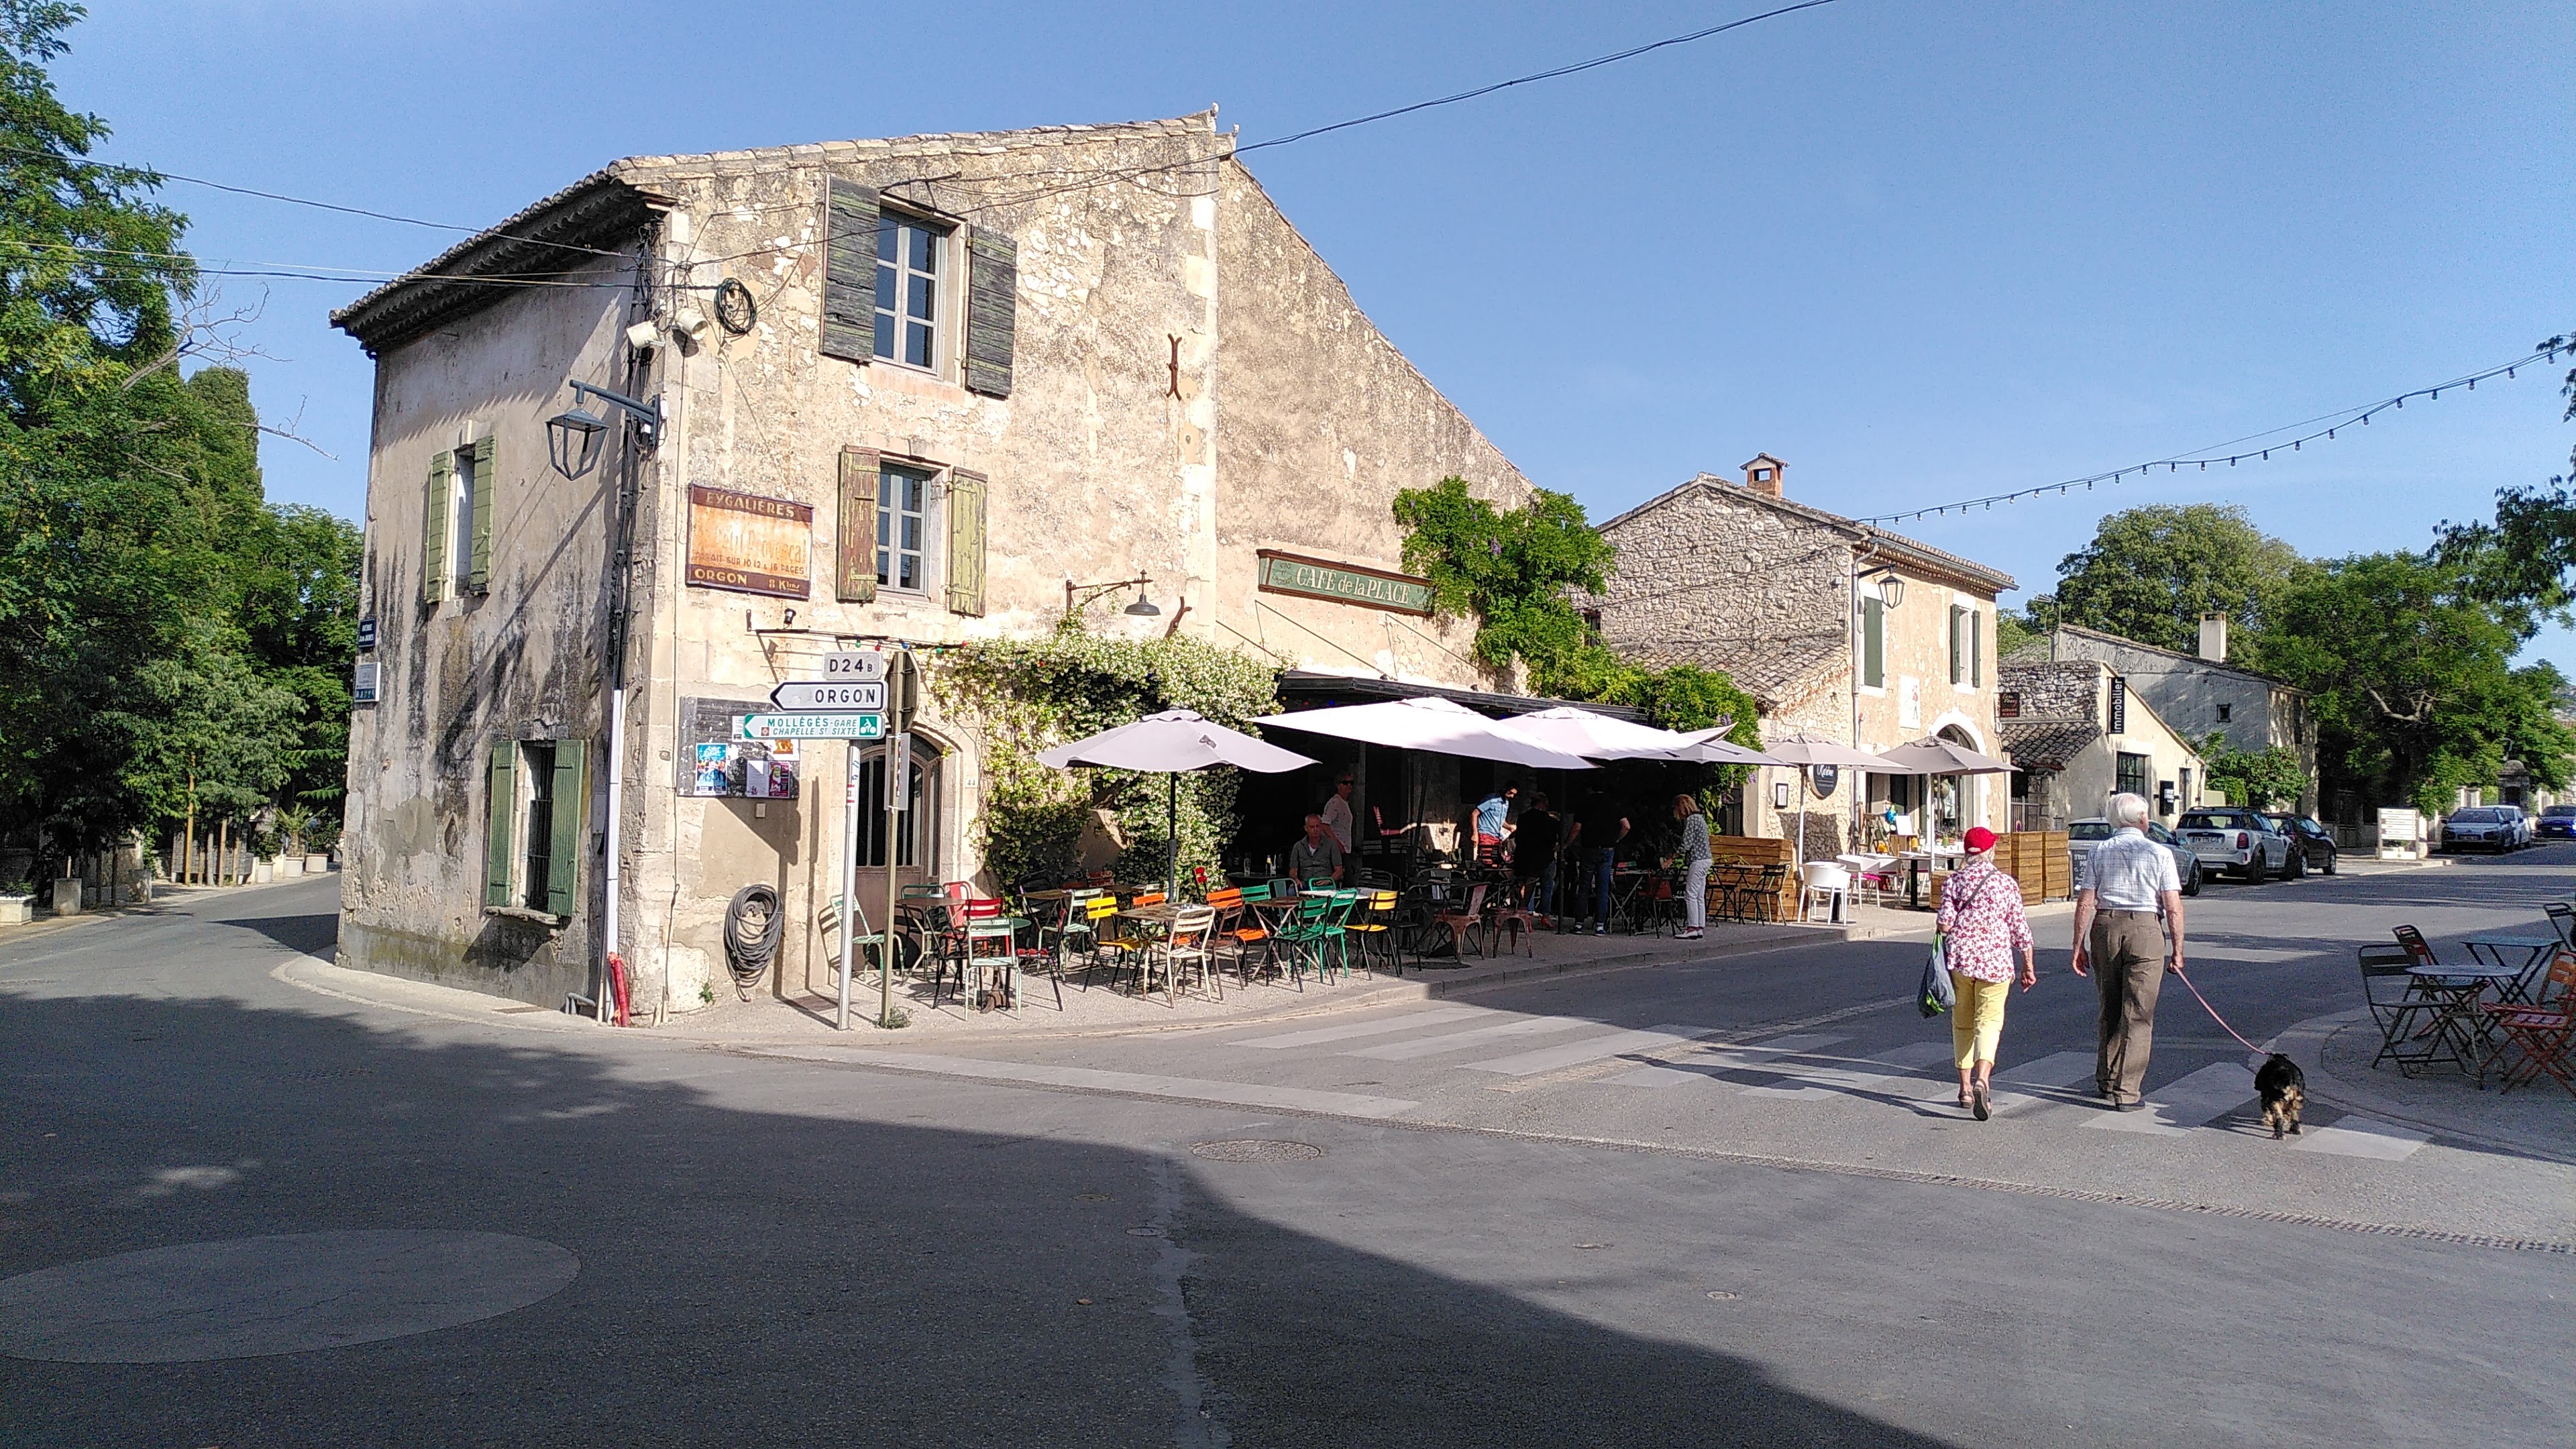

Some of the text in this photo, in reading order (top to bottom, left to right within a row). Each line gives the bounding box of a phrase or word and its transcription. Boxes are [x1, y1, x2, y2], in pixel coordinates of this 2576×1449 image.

[706, 492, 795, 518] EYGALIÈRES
[727, 556, 741, 566] SUR
[781, 564, 804, 575] PAGES
[694, 568, 748, 586] ORGON
[769, 578, 776, 589] 8
[1296, 567, 1410, 604] CAFÉ de la PLACE
[815, 688, 875, 704] ORGON
[2112, 678, 2123, 733] immobilier
[773, 727, 814, 735] CHAPELLE
[832, 727, 857, 735] SIXTE
